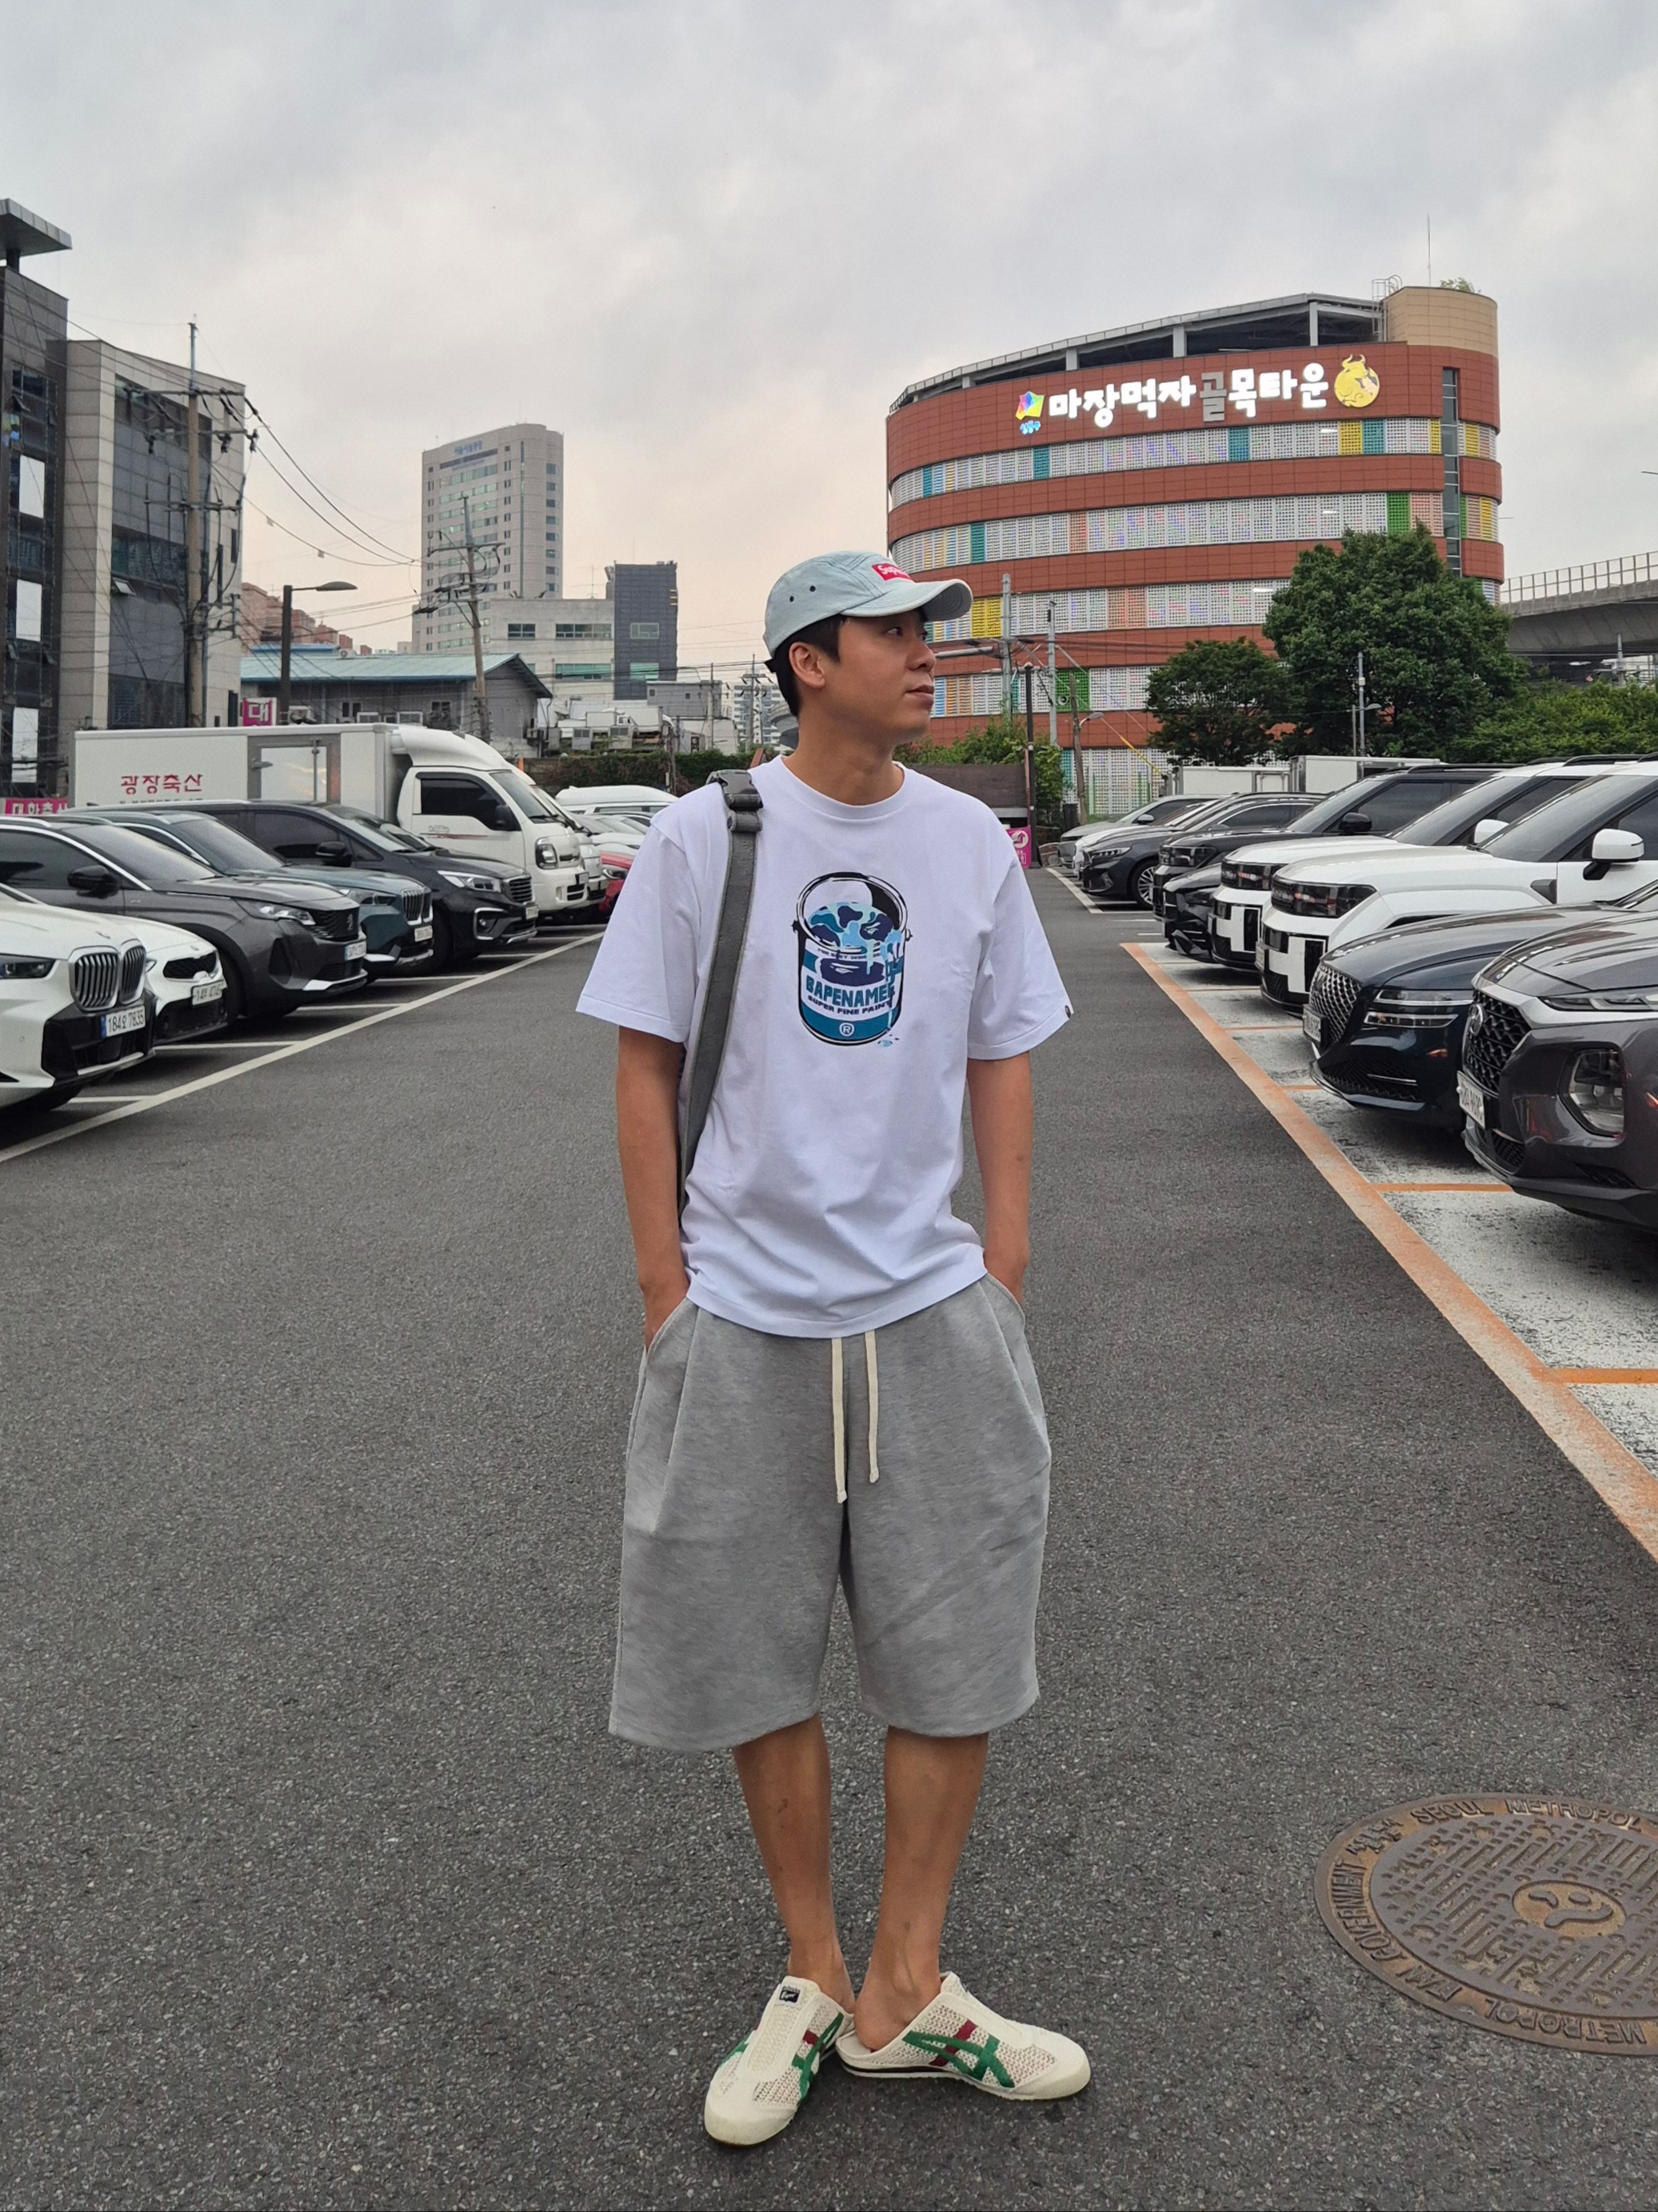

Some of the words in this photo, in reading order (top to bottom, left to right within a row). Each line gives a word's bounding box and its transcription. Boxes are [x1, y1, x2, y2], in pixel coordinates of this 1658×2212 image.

[1049, 362, 1329, 429] 마장먹자골목타운
[121, 774, 203, 795] 광장축산
[808, 994, 834, 1012] SUPER
[837, 1006, 860, 1015] FINE
[1410, 1800, 1494, 1825] SEOUL
